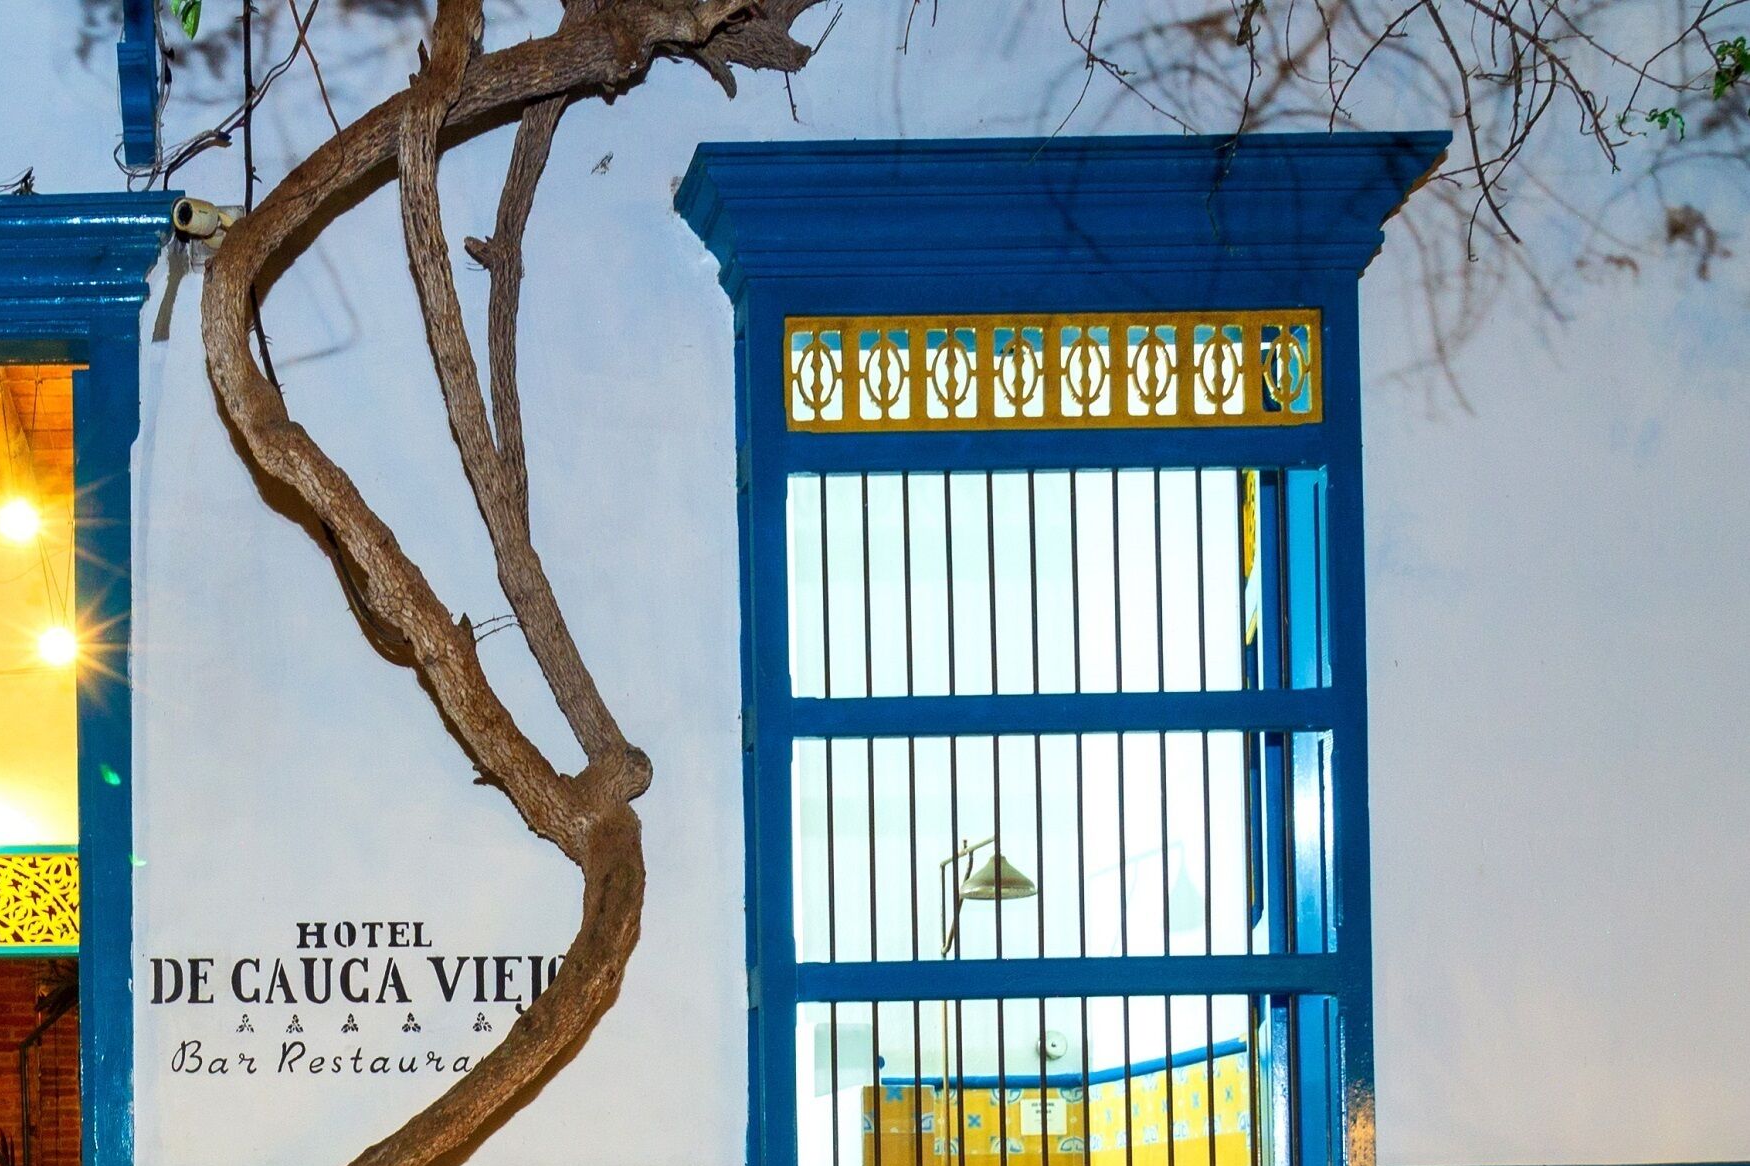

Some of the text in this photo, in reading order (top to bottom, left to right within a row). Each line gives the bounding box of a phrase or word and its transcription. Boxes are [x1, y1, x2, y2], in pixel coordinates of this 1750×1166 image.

[296, 921, 433, 949] HOTEL
[149, 957, 214, 1005] DE
[230, 956, 413, 1005] CAUCA
[170, 1040, 485, 1074] Bar Restaura
